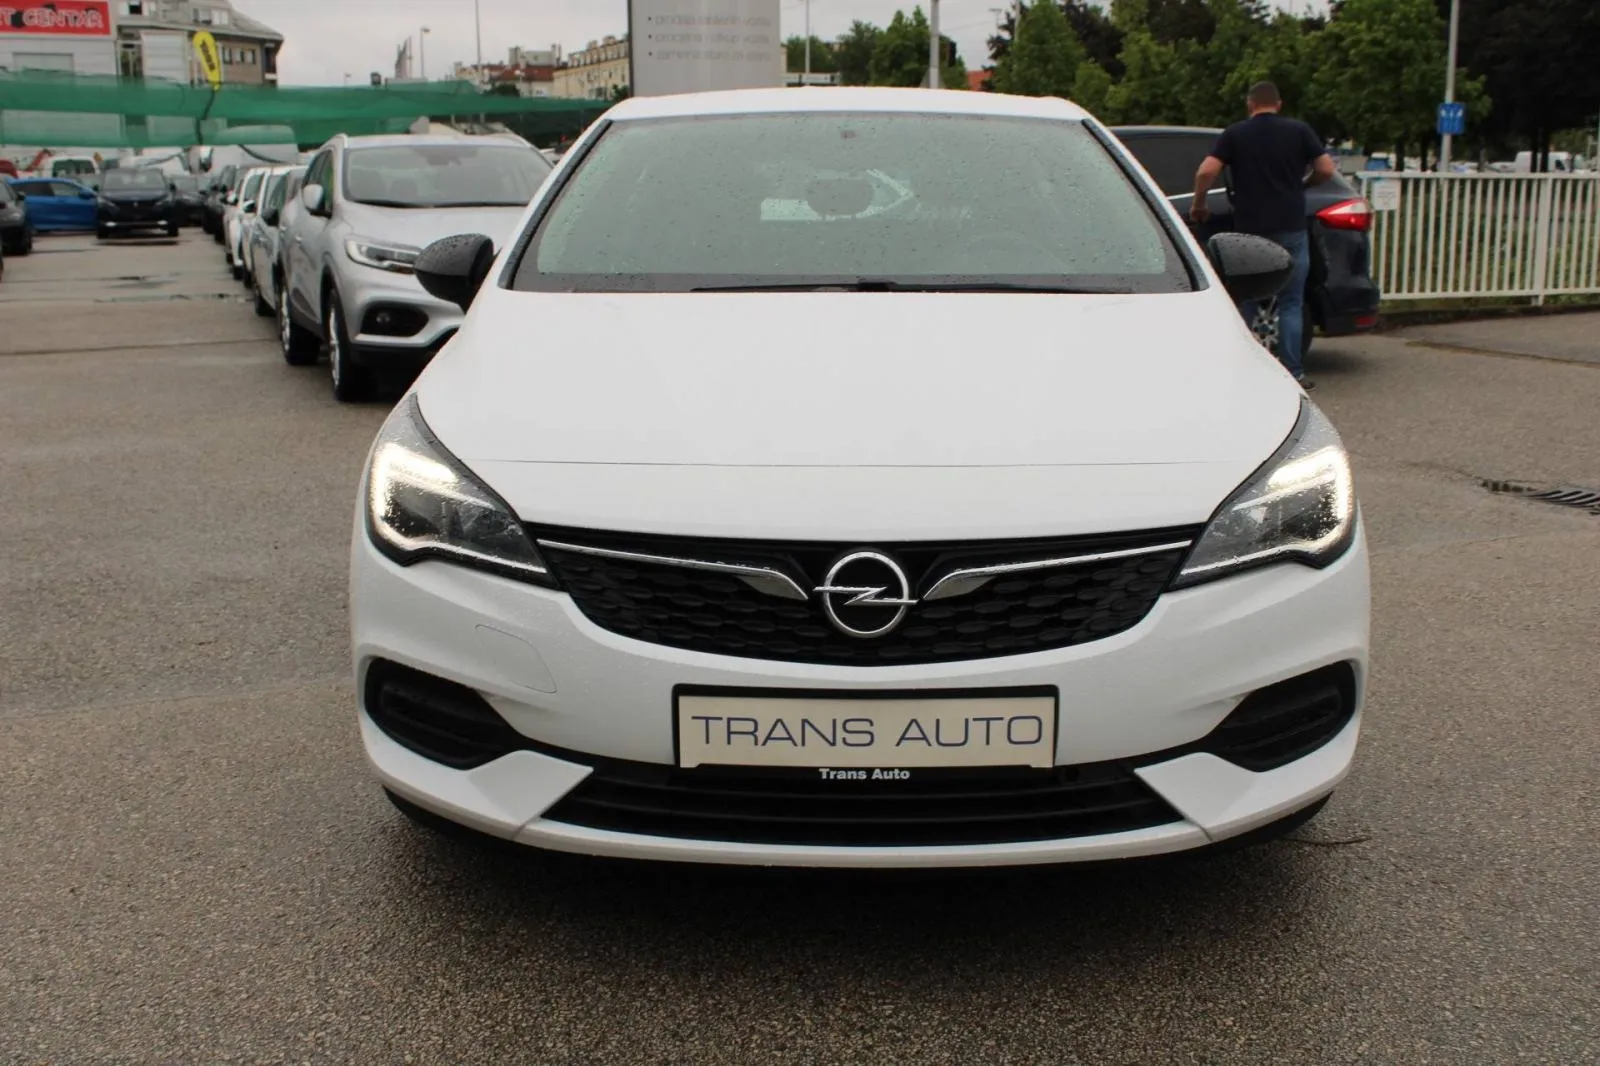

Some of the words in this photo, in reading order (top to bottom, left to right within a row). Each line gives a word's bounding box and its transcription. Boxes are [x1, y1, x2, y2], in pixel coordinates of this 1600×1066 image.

[0, 7, 16, 26] T
[22, 7, 104, 29] CENTAR
[691, 715, 876, 747] TRANS
[895, 715, 1043, 747] AUTO
[819, 768, 867, 780] Trans
[871, 768, 911, 780] Auto
